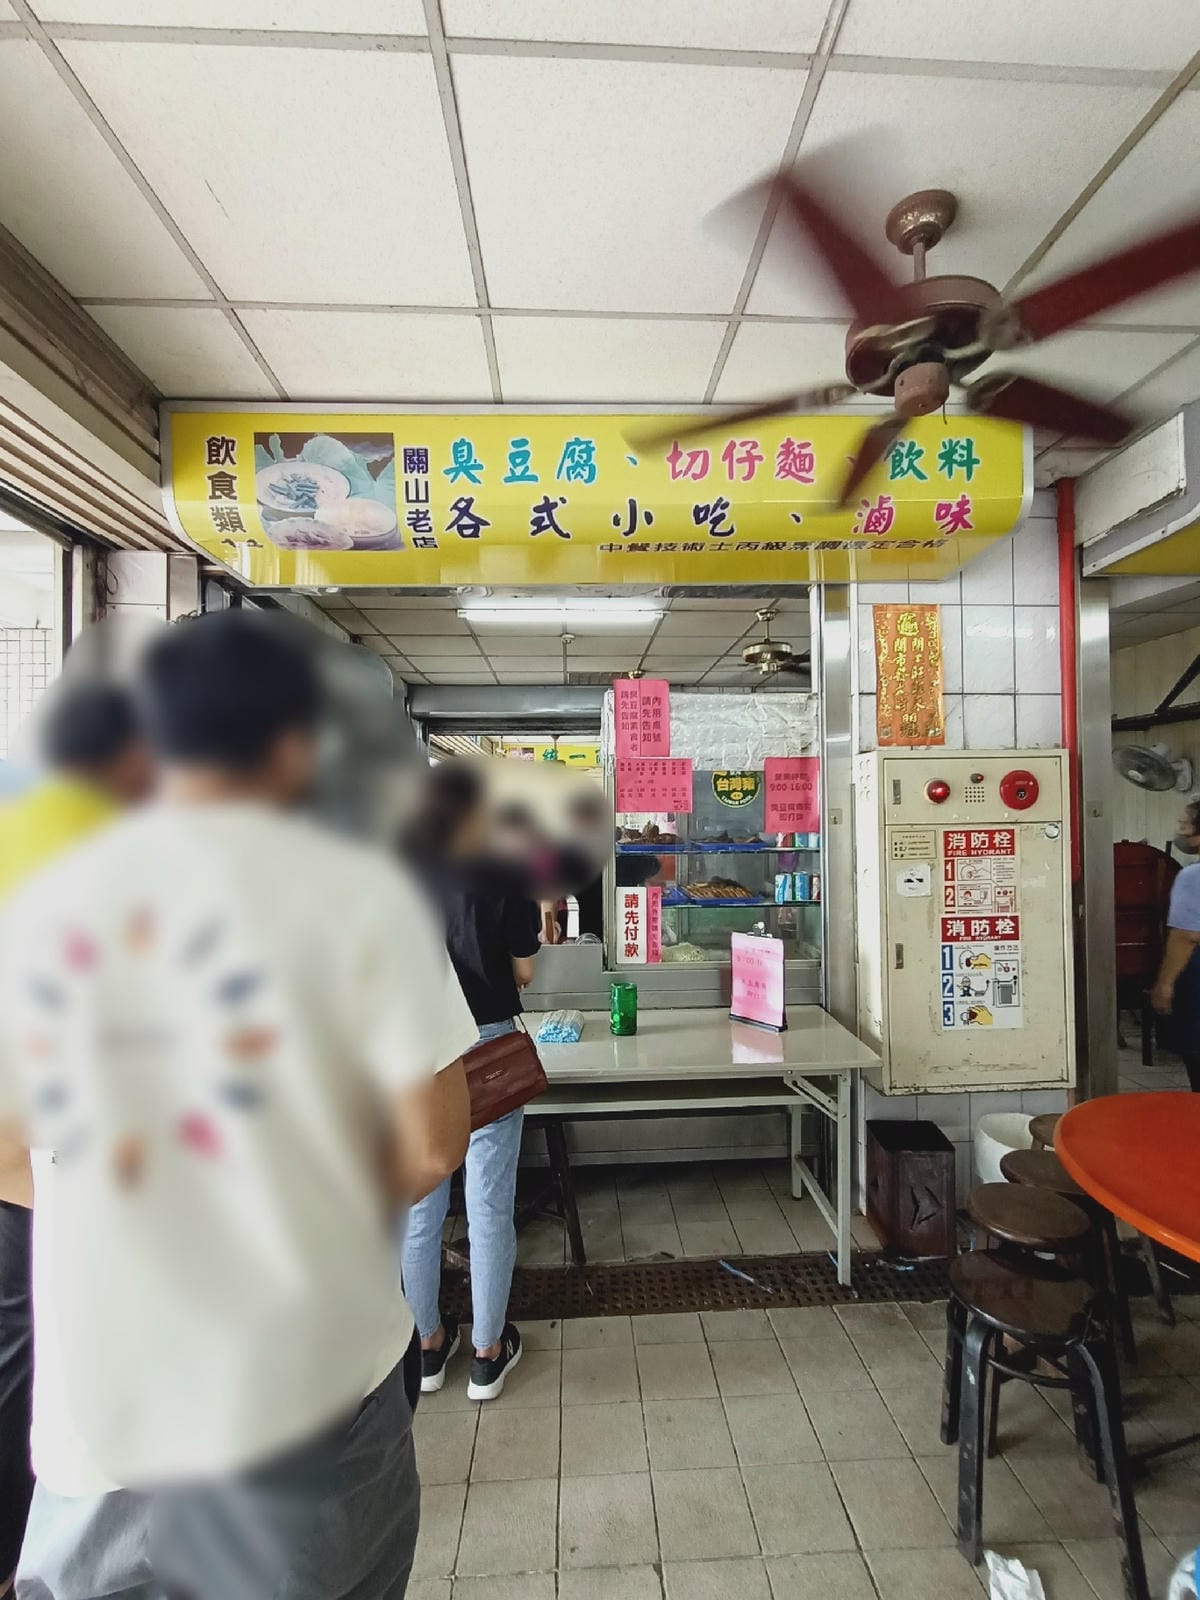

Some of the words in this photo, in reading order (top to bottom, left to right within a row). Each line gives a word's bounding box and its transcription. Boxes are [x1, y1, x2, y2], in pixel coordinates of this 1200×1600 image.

[403, 448, 438, 548] 關山老店
[947, 831, 1012, 850] 消防栓
[946, 861, 953, 880] 1
[945, 887, 955, 906] 2
[624, 893, 639, 957] 請先付款
[946, 919, 1015, 936] 消防栓
[943, 947, 951, 969] 1
[943, 976, 953, 998] 2
[944, 1004, 954, 1025] 3
